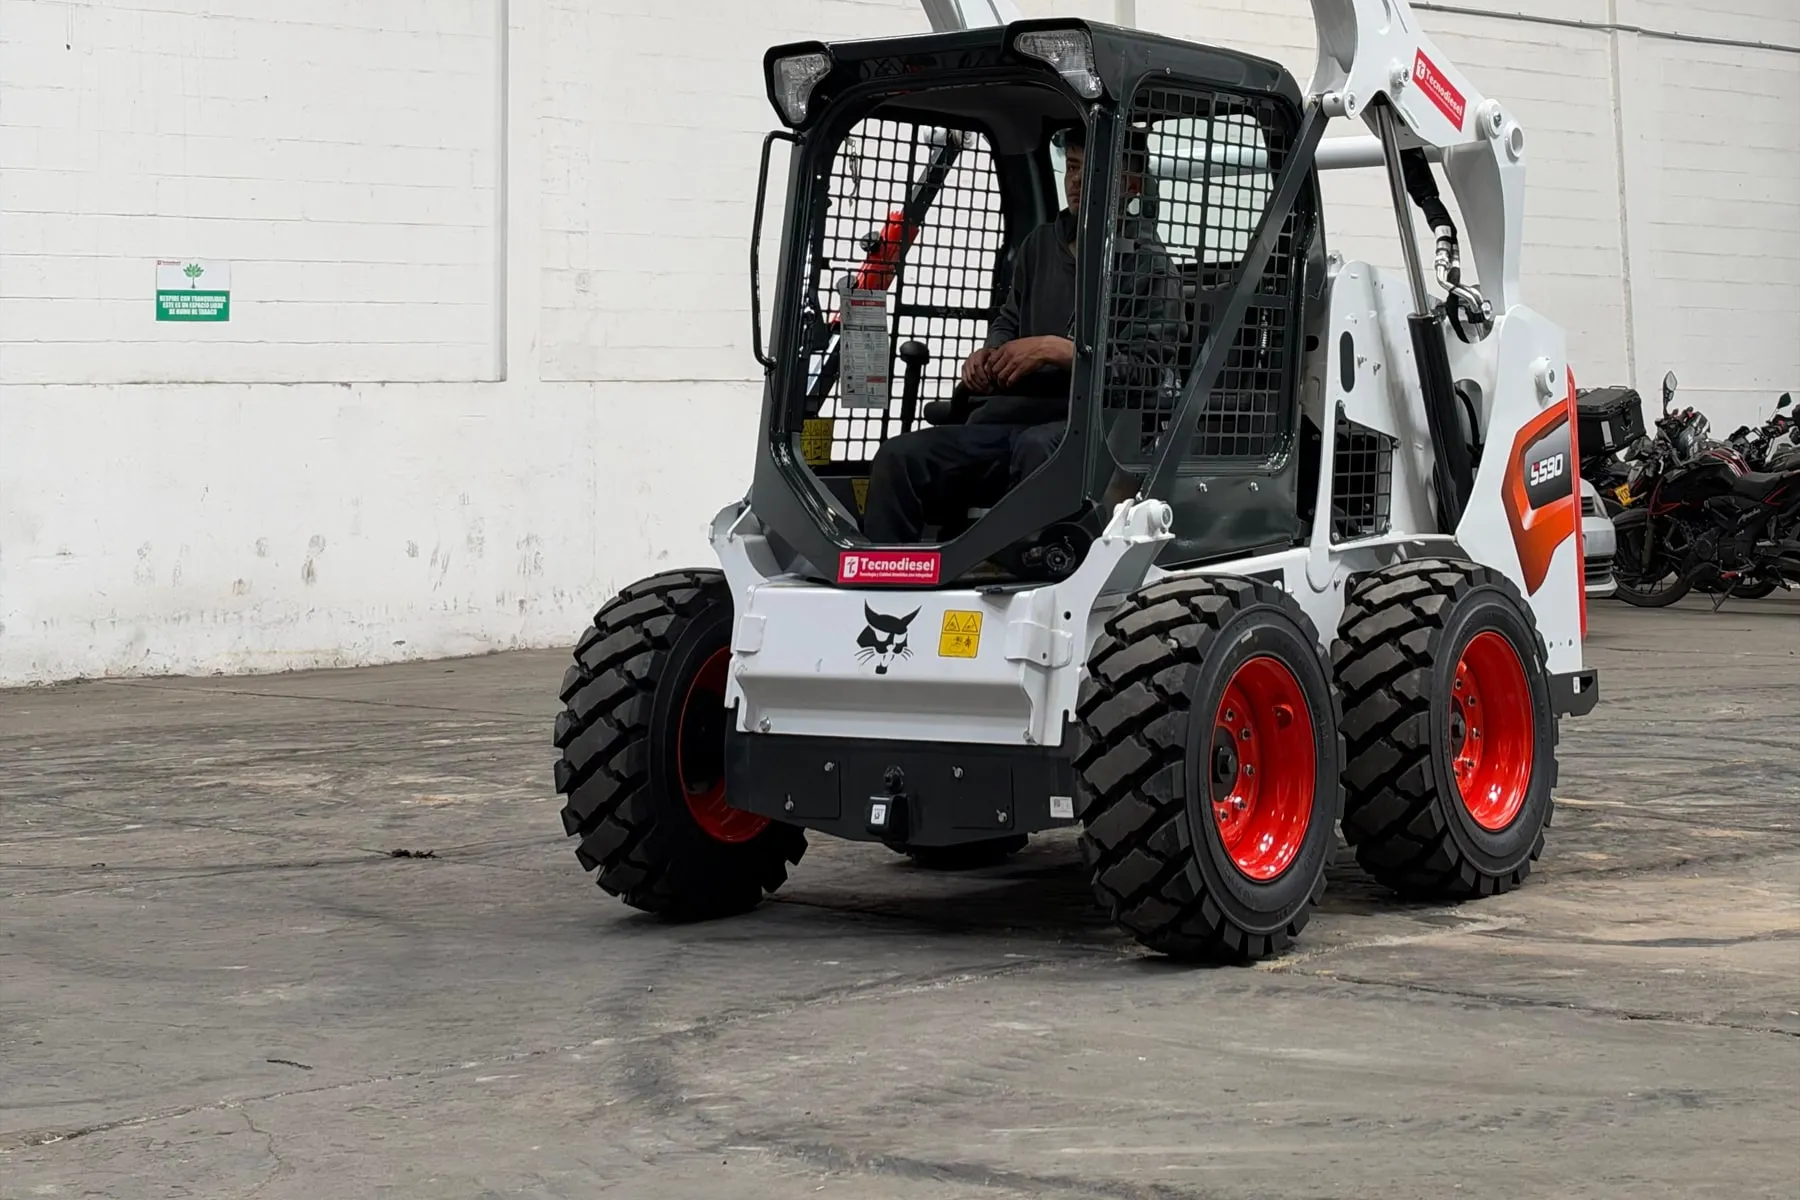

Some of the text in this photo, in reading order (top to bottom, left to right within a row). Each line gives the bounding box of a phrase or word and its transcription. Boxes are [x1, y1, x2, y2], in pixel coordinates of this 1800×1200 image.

[1425, 68, 1463, 117] Tecnodiesel
[1530, 453, 1563, 486] S590
[860, 557, 935, 571] Tecnodiesel
